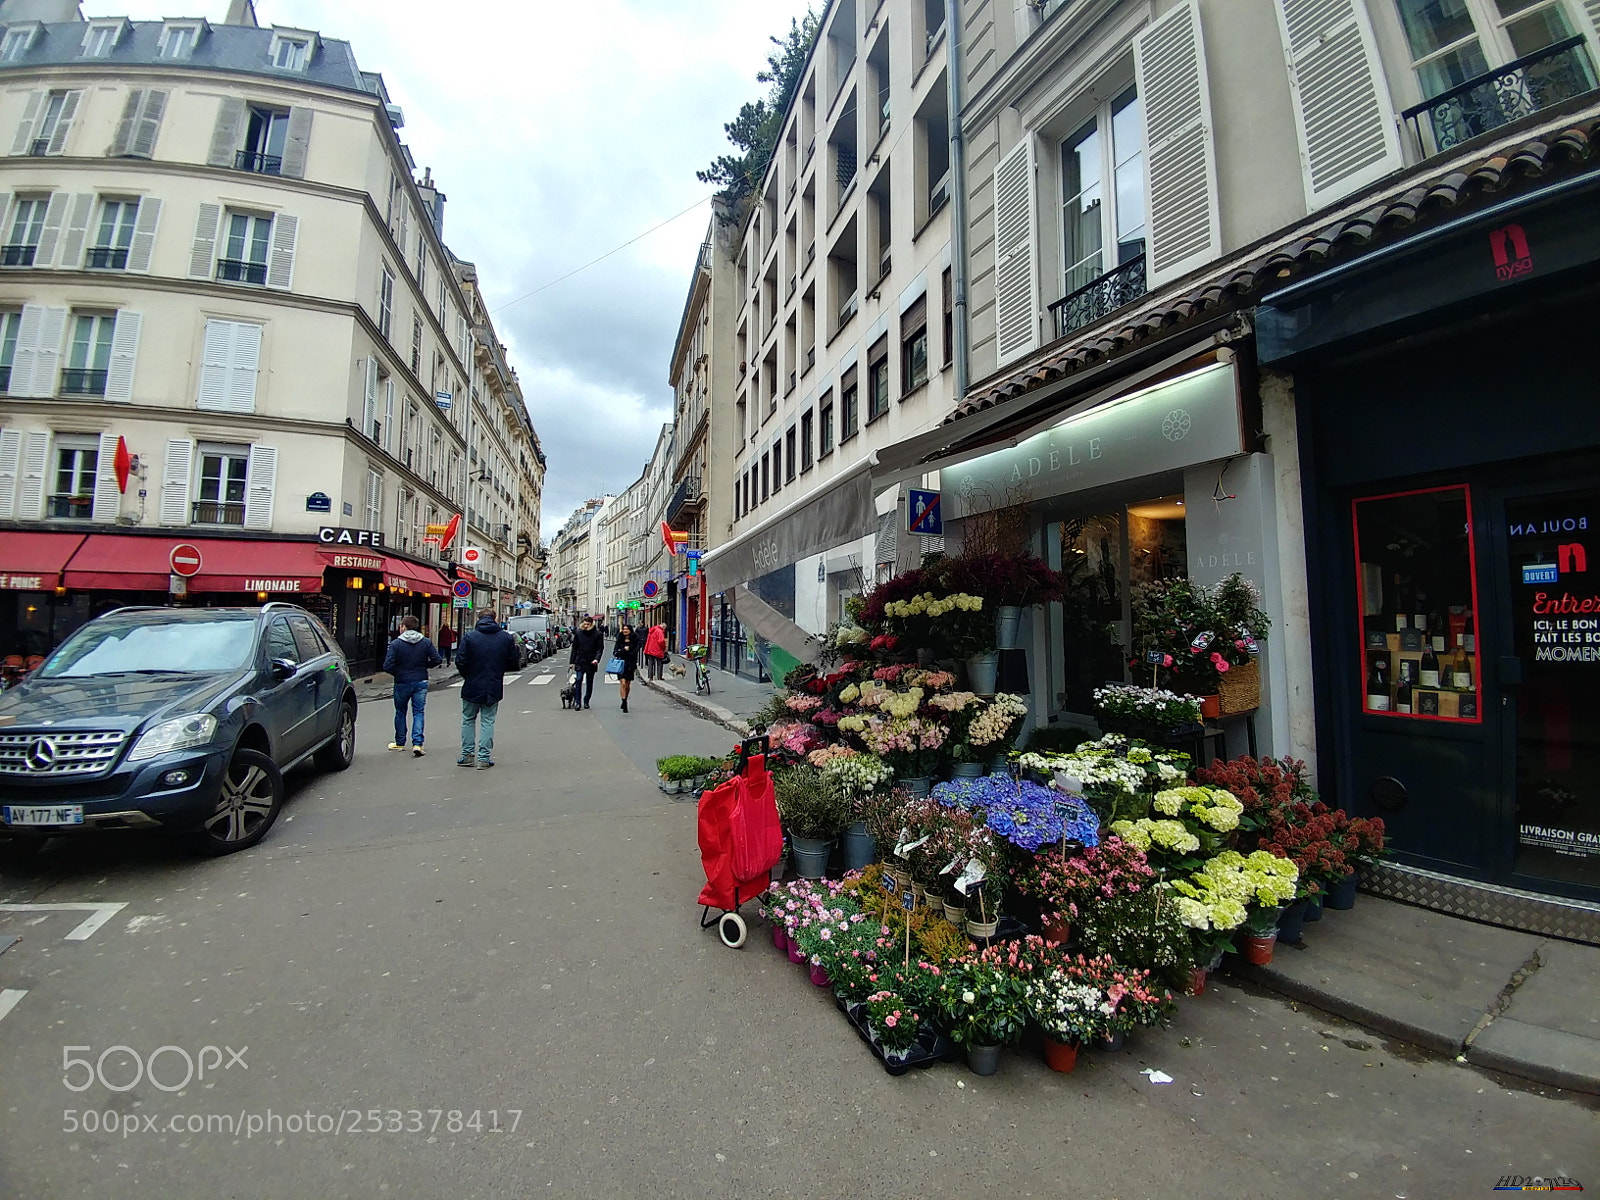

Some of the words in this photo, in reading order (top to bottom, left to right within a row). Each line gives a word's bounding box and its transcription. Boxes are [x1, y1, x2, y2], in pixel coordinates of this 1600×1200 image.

[1010, 437, 1103, 482] ADÈLE
[320, 528, 380, 546] CAFE
[334, 555, 382, 569] RESTAURANT
[752, 539, 779, 571] Adèle
[1197, 549, 1256, 568] ADÈLE
[1524, 571, 1555, 581] OUVERT
[244, 579, 301, 591] LIMONADE
[1534, 620, 1553, 631] ICI,
[1557, 620, 1568, 630] LE
[1572, 619, 1598, 630] BON
[1534, 633, 1558, 643] FAIT
[1562, 633, 1582, 643] LES
[1520, 824, 1574, 841] LIVRAISON
